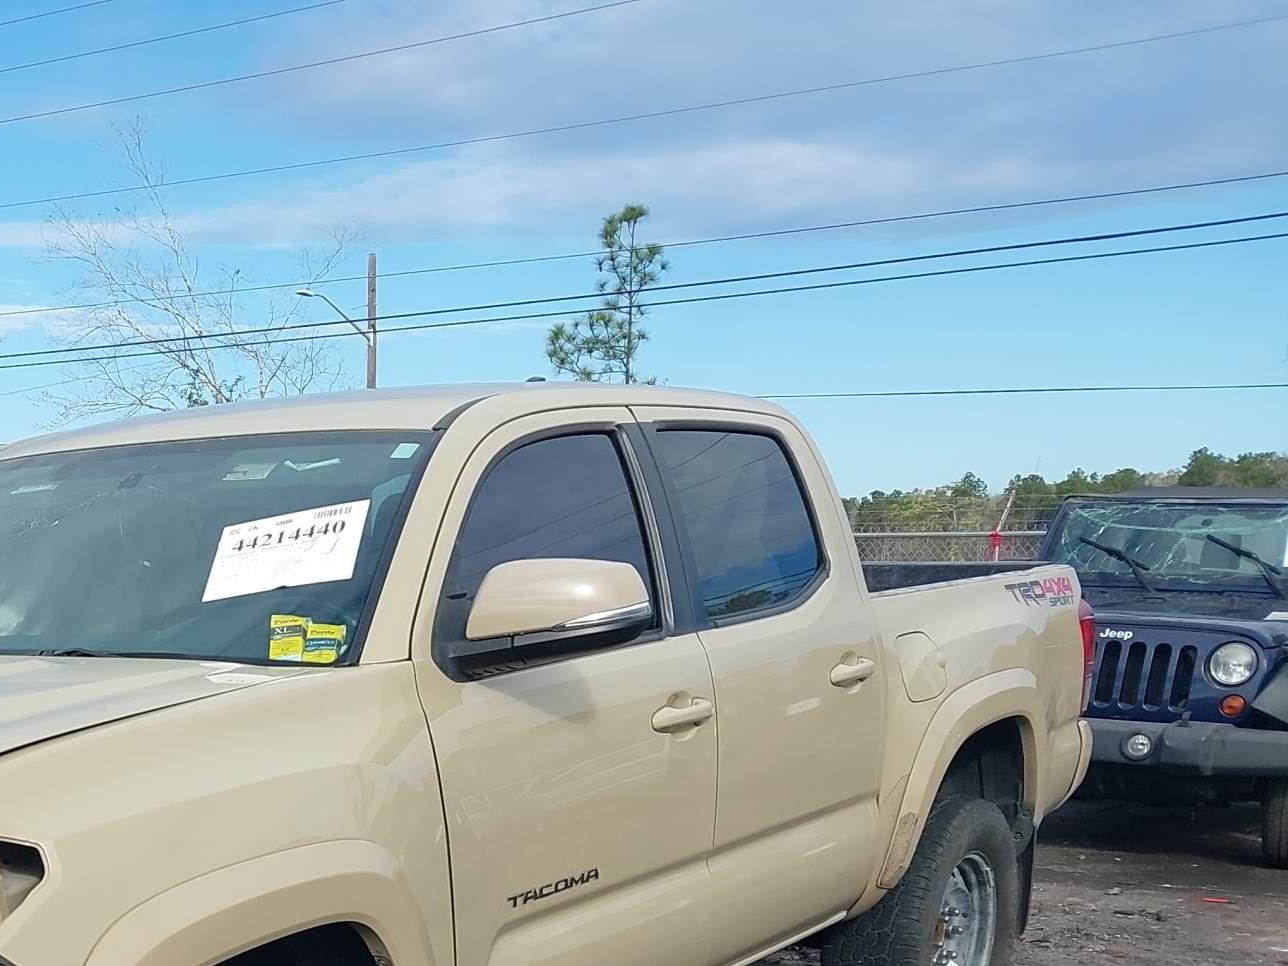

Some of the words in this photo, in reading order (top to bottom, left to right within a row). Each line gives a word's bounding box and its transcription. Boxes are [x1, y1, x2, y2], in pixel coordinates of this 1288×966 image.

[232, 519, 347, 552] 44214440
[1048, 595, 1074, 606] SPORT
[1099, 627, 1133, 640] Jeep
[507, 867, 599, 908] TACOMA
